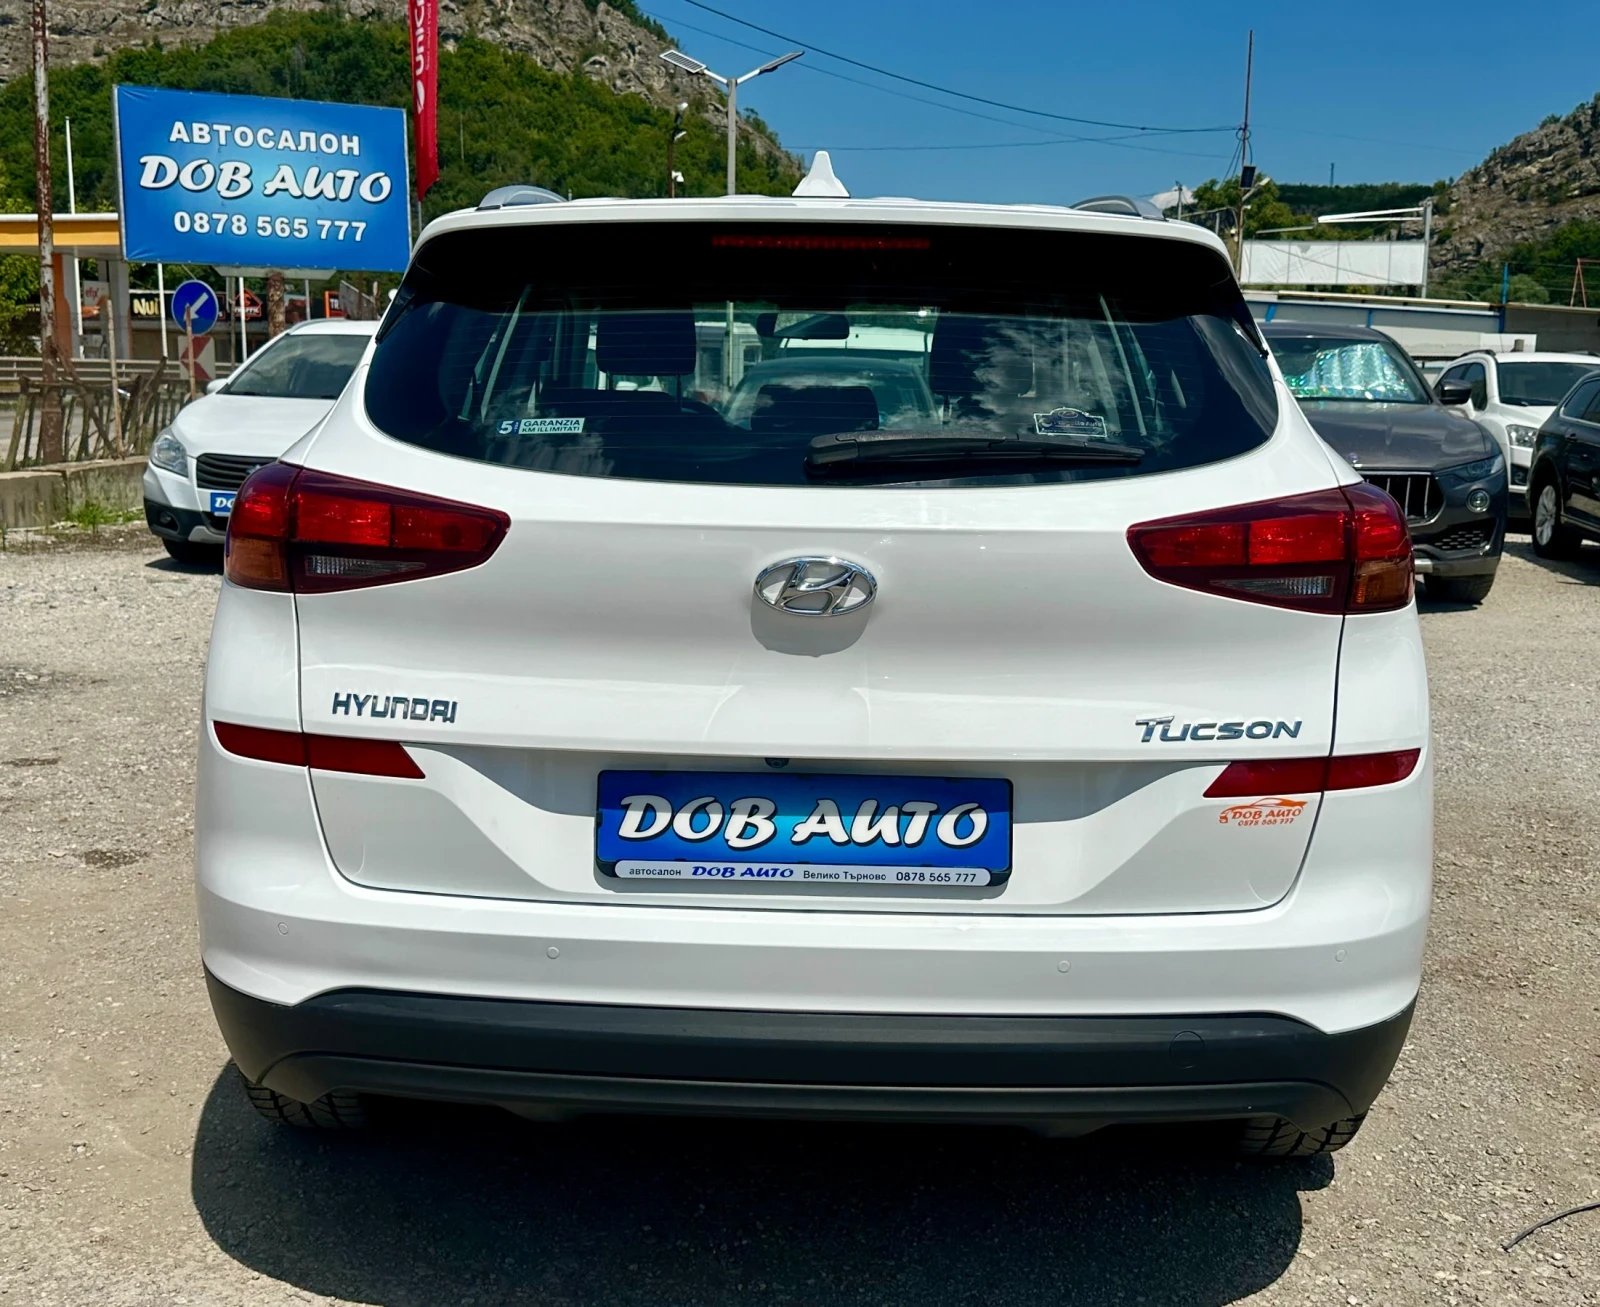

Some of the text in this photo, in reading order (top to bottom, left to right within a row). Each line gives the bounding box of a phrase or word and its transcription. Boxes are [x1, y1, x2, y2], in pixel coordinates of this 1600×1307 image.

[169, 121, 361, 156] АВТОСАЛОН
[139, 155, 392, 203] DOB AUTO
[173, 211, 367, 242] 0878 565 777
[498, 420, 514, 435] 5
[523, 419, 581, 428] GARANZIA
[332, 692, 458, 724] HYUNDAI
[1135, 715, 1303, 743] TUCSON
[618, 793, 989, 849] DOB AUTO
[1231, 808, 1302, 820] DOB AUTO
[1279, 817, 1294, 825] 777
[628, 866, 977, 883] автосалон DOB AUTO Велико Търново 0878 565 777
